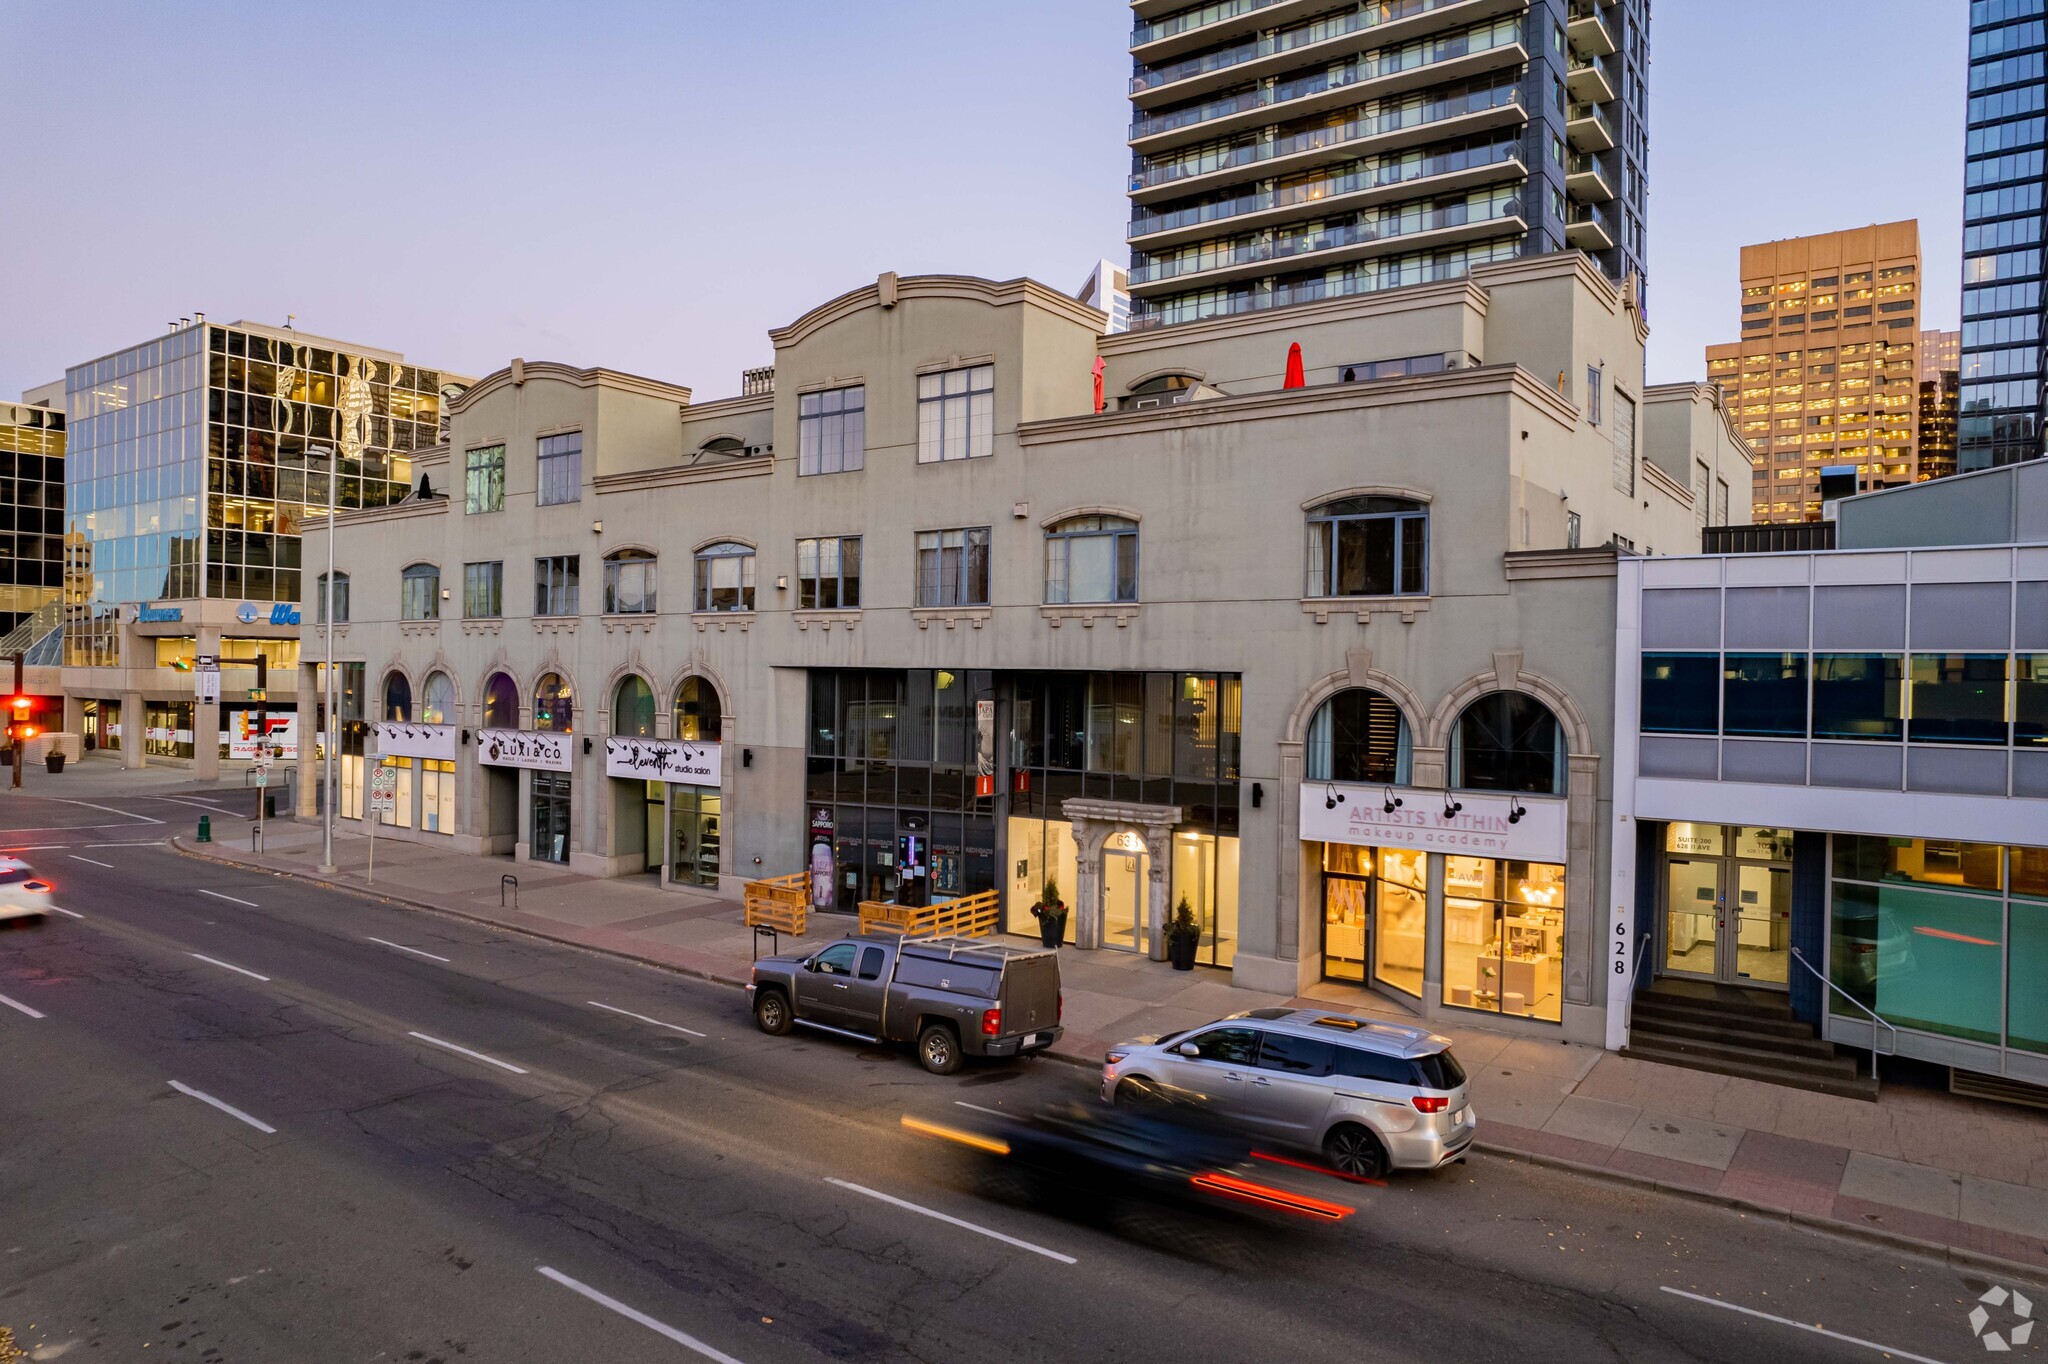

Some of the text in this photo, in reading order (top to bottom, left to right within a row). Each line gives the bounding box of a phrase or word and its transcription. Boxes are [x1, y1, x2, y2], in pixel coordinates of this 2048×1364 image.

[502, 745, 530, 756] LUXI
[533, 747, 540, 757] &
[674, 765, 711, 775] studio salon
[811, 820, 834, 829] SAPPORO
[1350, 806, 1509, 832] ARTISTS WITHIN
[1349, 826, 1508, 849] makeup academy
[1614, 922, 1626, 975] 628
